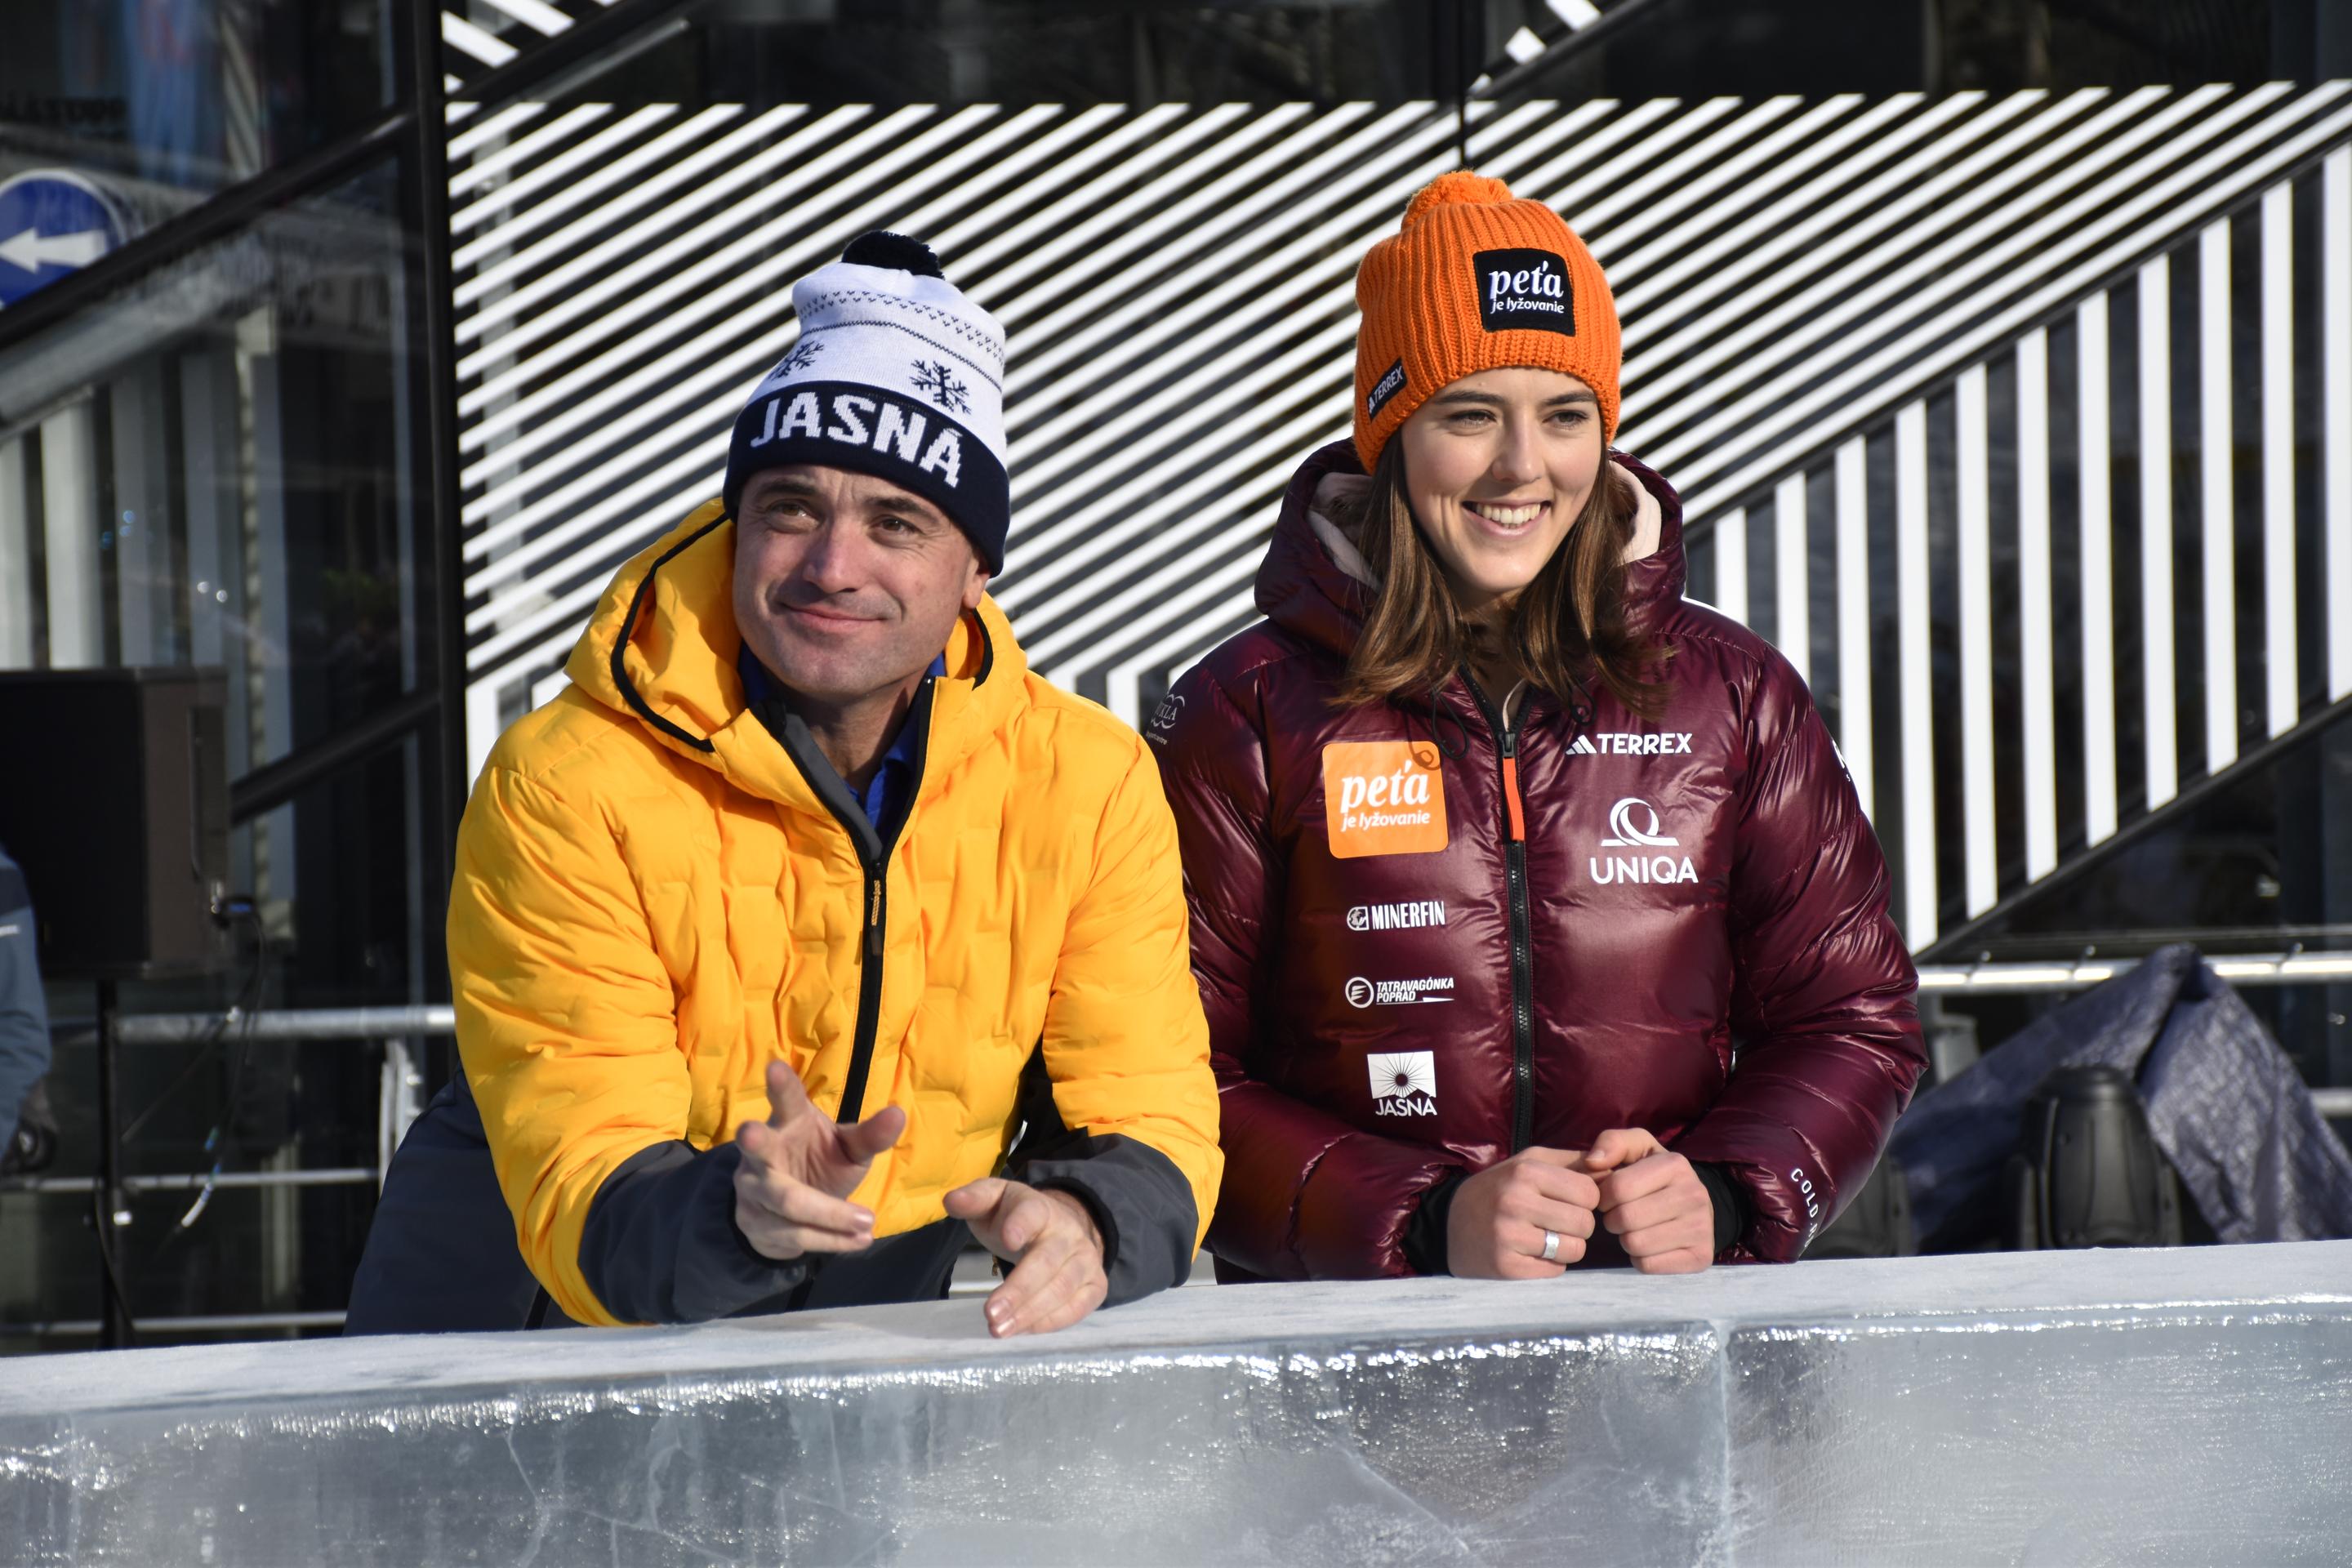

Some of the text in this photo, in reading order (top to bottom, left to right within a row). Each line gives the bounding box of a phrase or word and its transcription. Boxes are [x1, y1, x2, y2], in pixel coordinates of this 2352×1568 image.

[1490, 296, 1565, 314] je lyžovanie
[1374, 366, 1403, 403] TERREX
[1597, 733, 1693, 755] TERREX
[1341, 810, 1431, 832] je lyžovanie
[1590, 856, 1699, 884] UNIQA
[1372, 901, 1446, 929] MINERFIN
[1376, 977, 1454, 992] TATRAVAGÓNKA
[1376, 991, 1416, 1003] POPRAD
